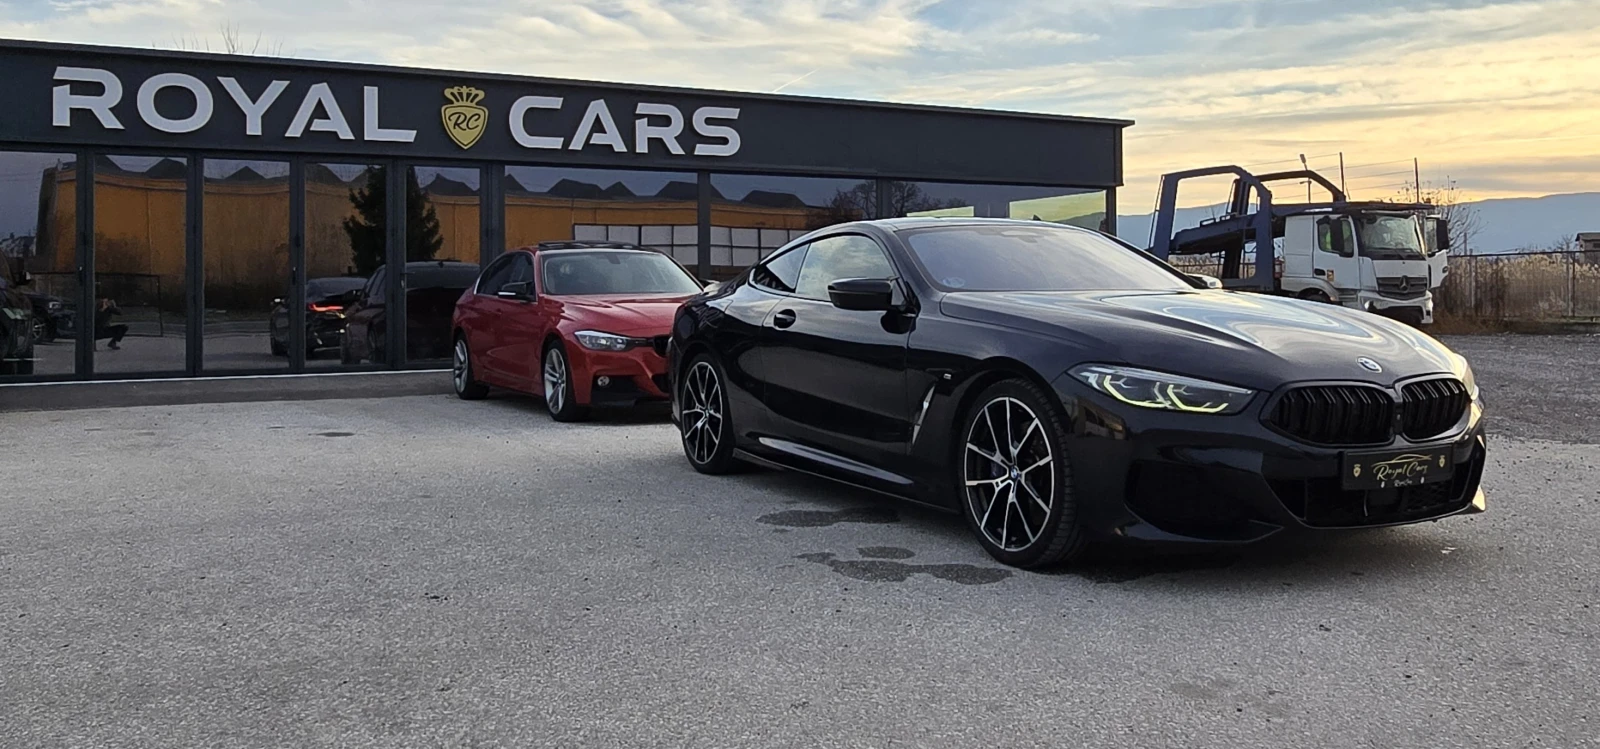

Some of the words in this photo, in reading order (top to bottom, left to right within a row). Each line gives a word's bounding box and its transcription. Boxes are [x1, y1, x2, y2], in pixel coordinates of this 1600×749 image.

[52, 66, 418, 143] ROYAL
[508, 95, 741, 157] CARS
[447, 111, 482, 132] RC
[1373, 463, 1407, 481] Royal
[1406, 461, 1429, 477] Cars
